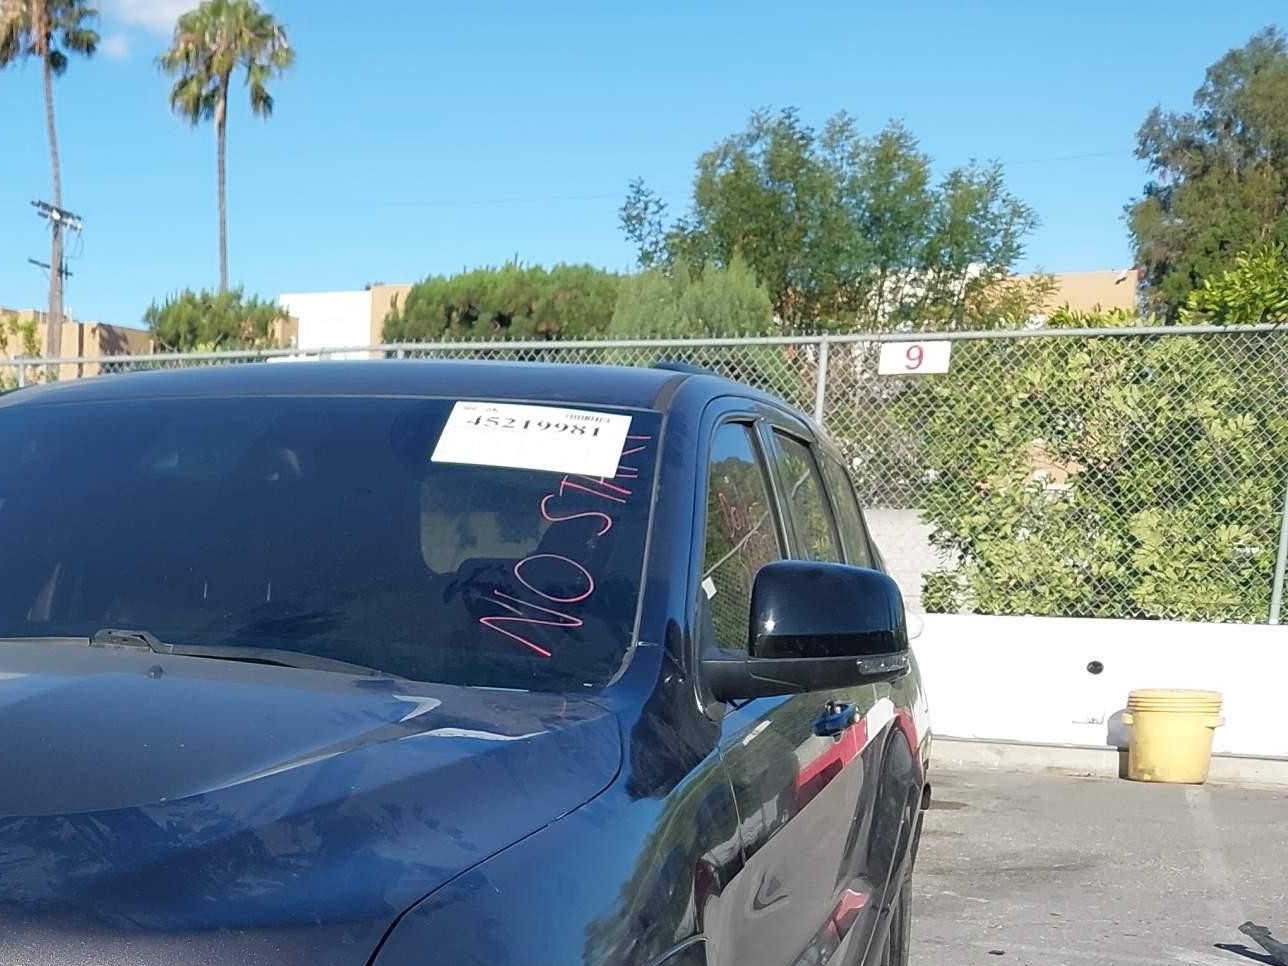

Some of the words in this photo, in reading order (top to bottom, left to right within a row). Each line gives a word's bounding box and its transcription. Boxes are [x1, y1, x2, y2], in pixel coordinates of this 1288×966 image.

[905, 344, 924, 370] 9
[465, 414, 602, 438] 45219981
[479, 553, 595, 657] NO
